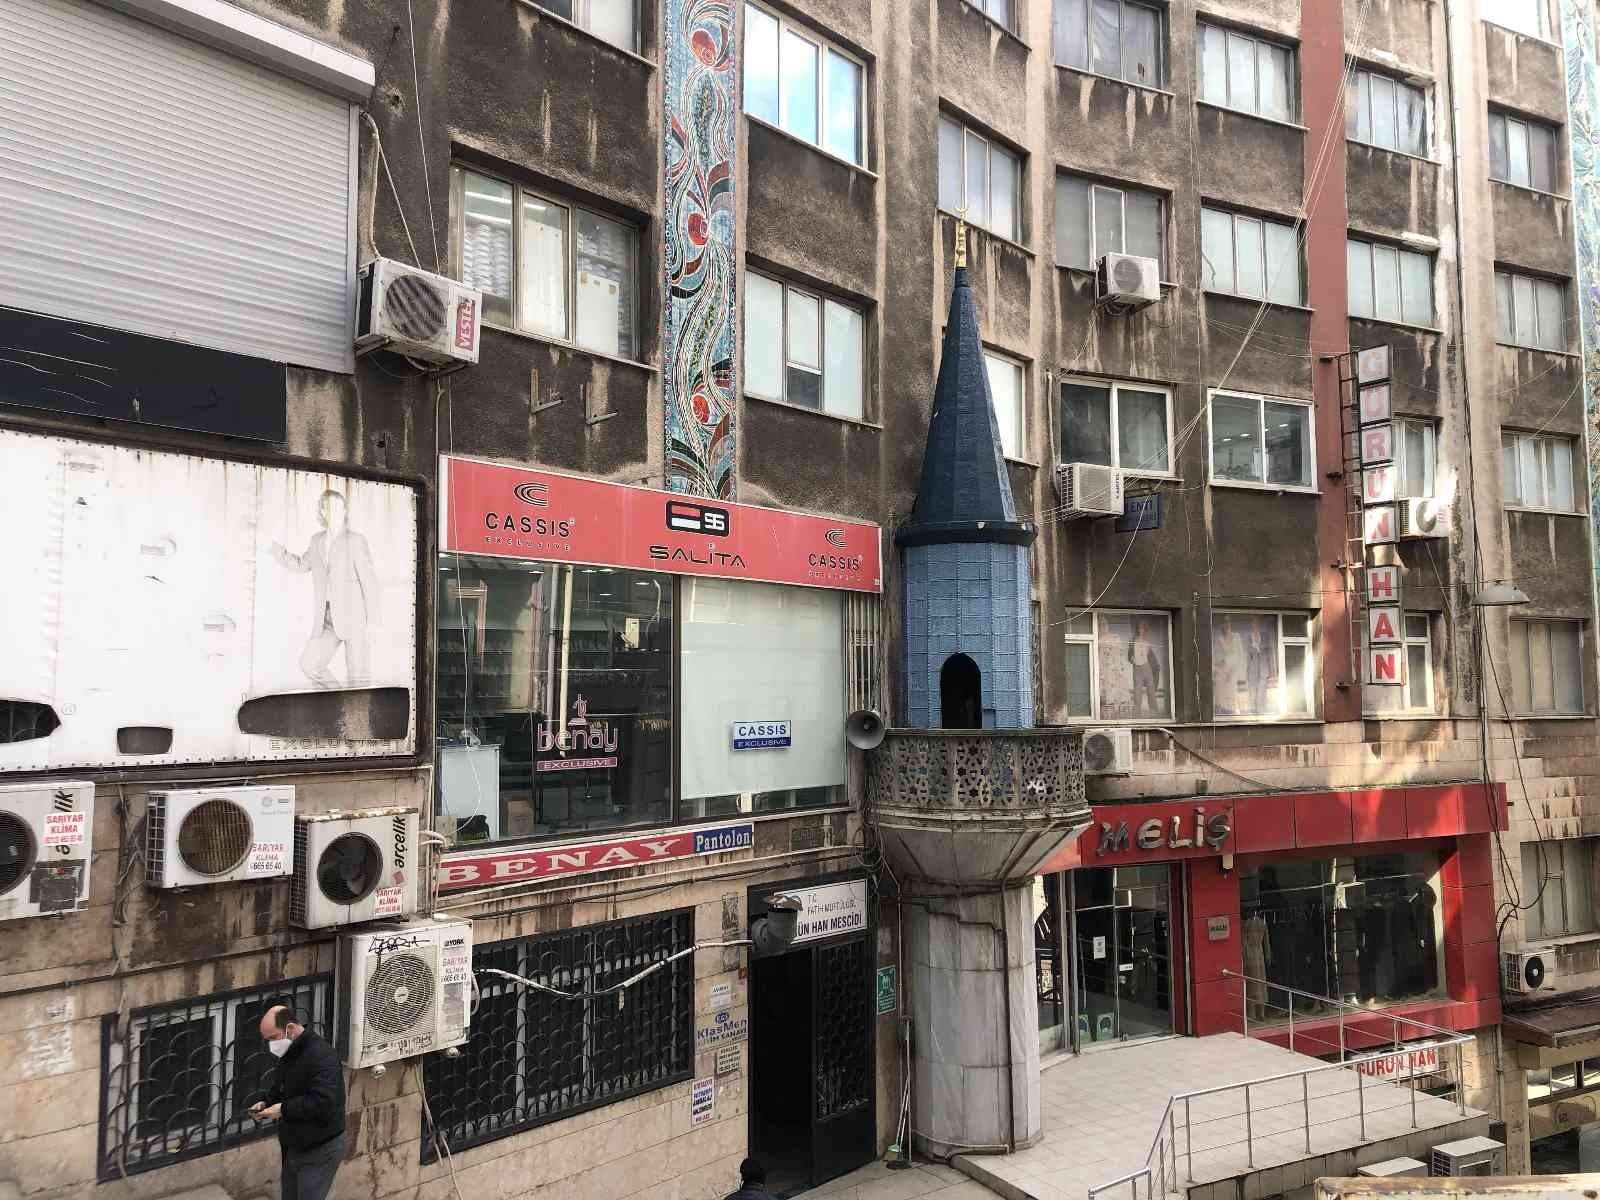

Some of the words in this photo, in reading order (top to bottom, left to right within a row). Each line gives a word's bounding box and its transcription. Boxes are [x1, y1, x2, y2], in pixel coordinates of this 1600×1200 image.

[460, 301, 474, 348] VESTE
[485, 512, 570, 537] CASSIS
[808, 553, 860, 571] CASSIS
[1371, 571, 1396, 680] HAN
[537, 722, 618, 752] benay
[738, 724, 786, 737] CASSIS
[737, 739, 787, 748] EXCLUSIVE
[393, 816, 407, 868] arçelik
[695, 828, 750, 852] Pantolon
[439, 838, 682, 884] BENAY
[811, 919, 829, 933] HAN
